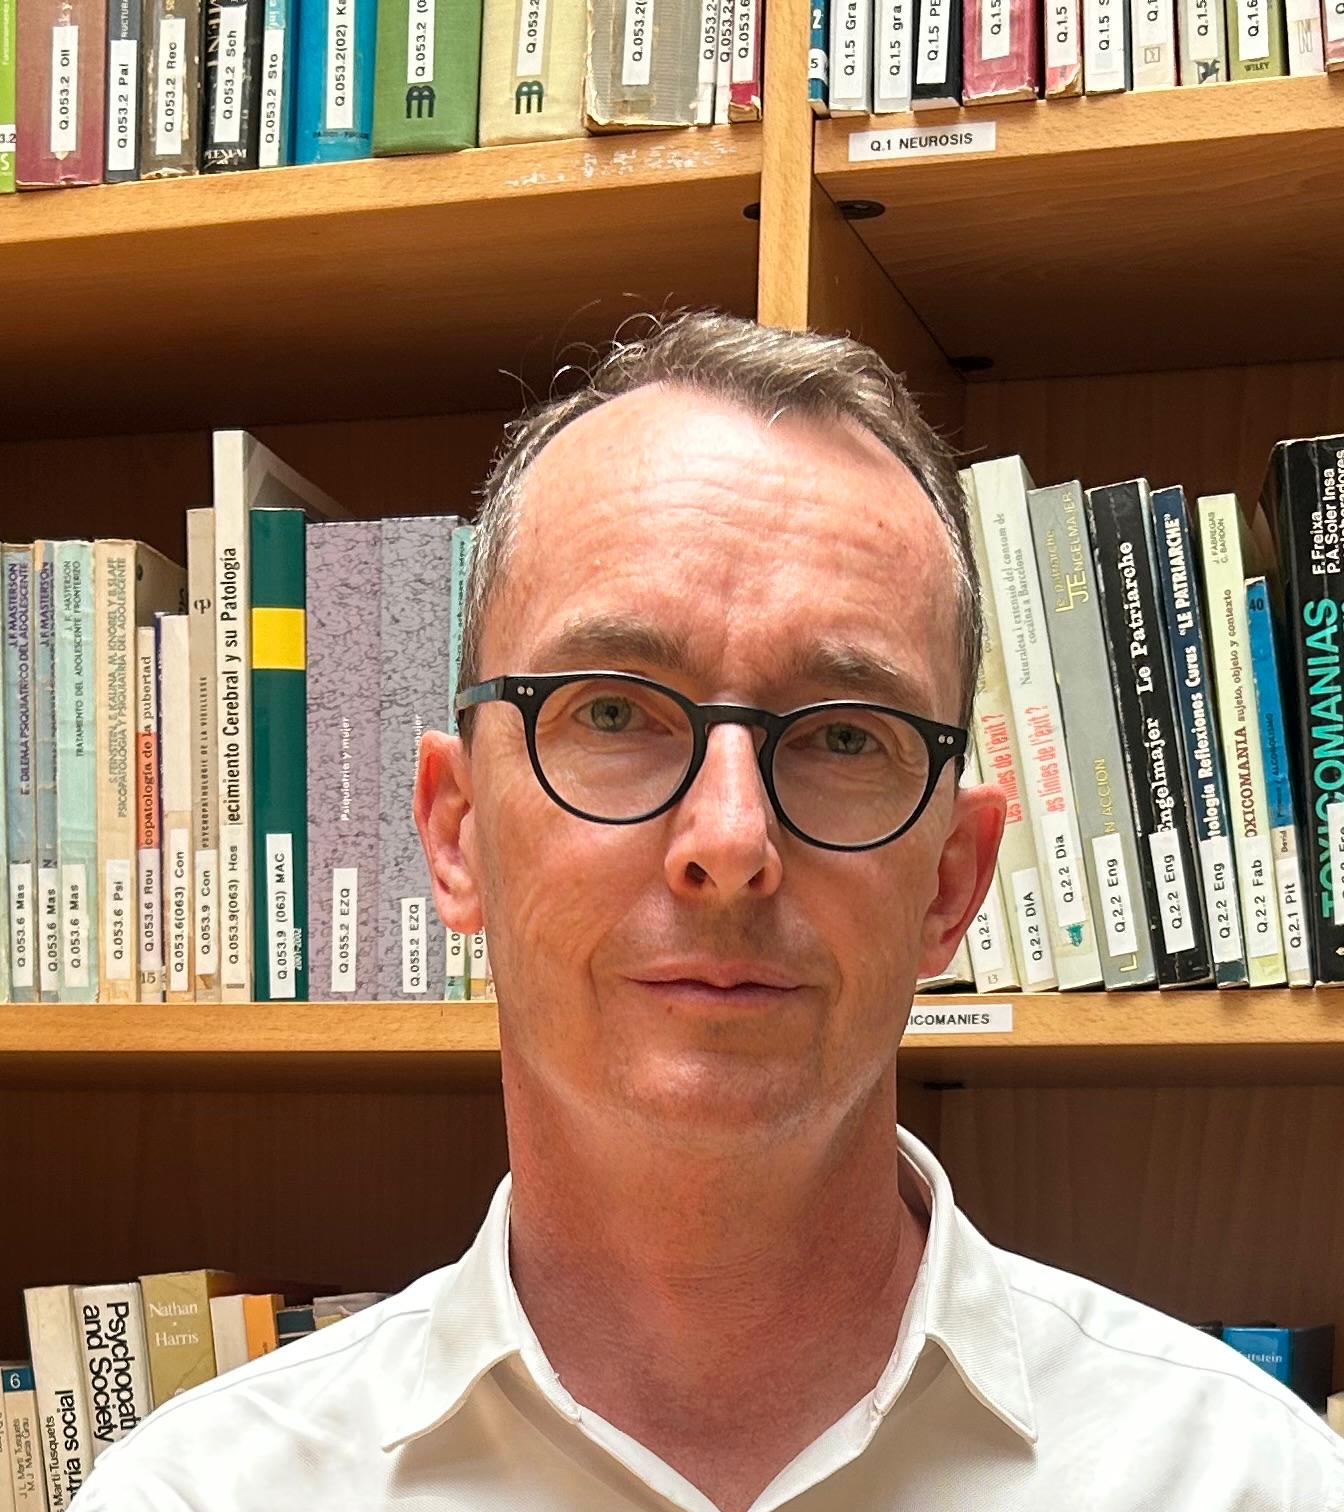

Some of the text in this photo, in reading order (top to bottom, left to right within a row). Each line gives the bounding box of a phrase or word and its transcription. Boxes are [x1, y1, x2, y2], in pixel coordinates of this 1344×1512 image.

[870, 131, 973, 151] Q.1 NEUROSIS
[1322, 468, 1336, 501] Insa
[1119, 541, 1153, 694] Le Patriarche
[220, 547, 242, 823] ecimiento Cerebral y su Patología
[339, 887, 351, 973] Q.055.2 EZQ
[910, 1014, 990, 1025] ICOMANIES
[149, 1301, 198, 1318] Nathan
[83, 1305, 103, 1351] and
[154, 1331, 199, 1347] Harris
[9, 1374, 21, 1389] 6
